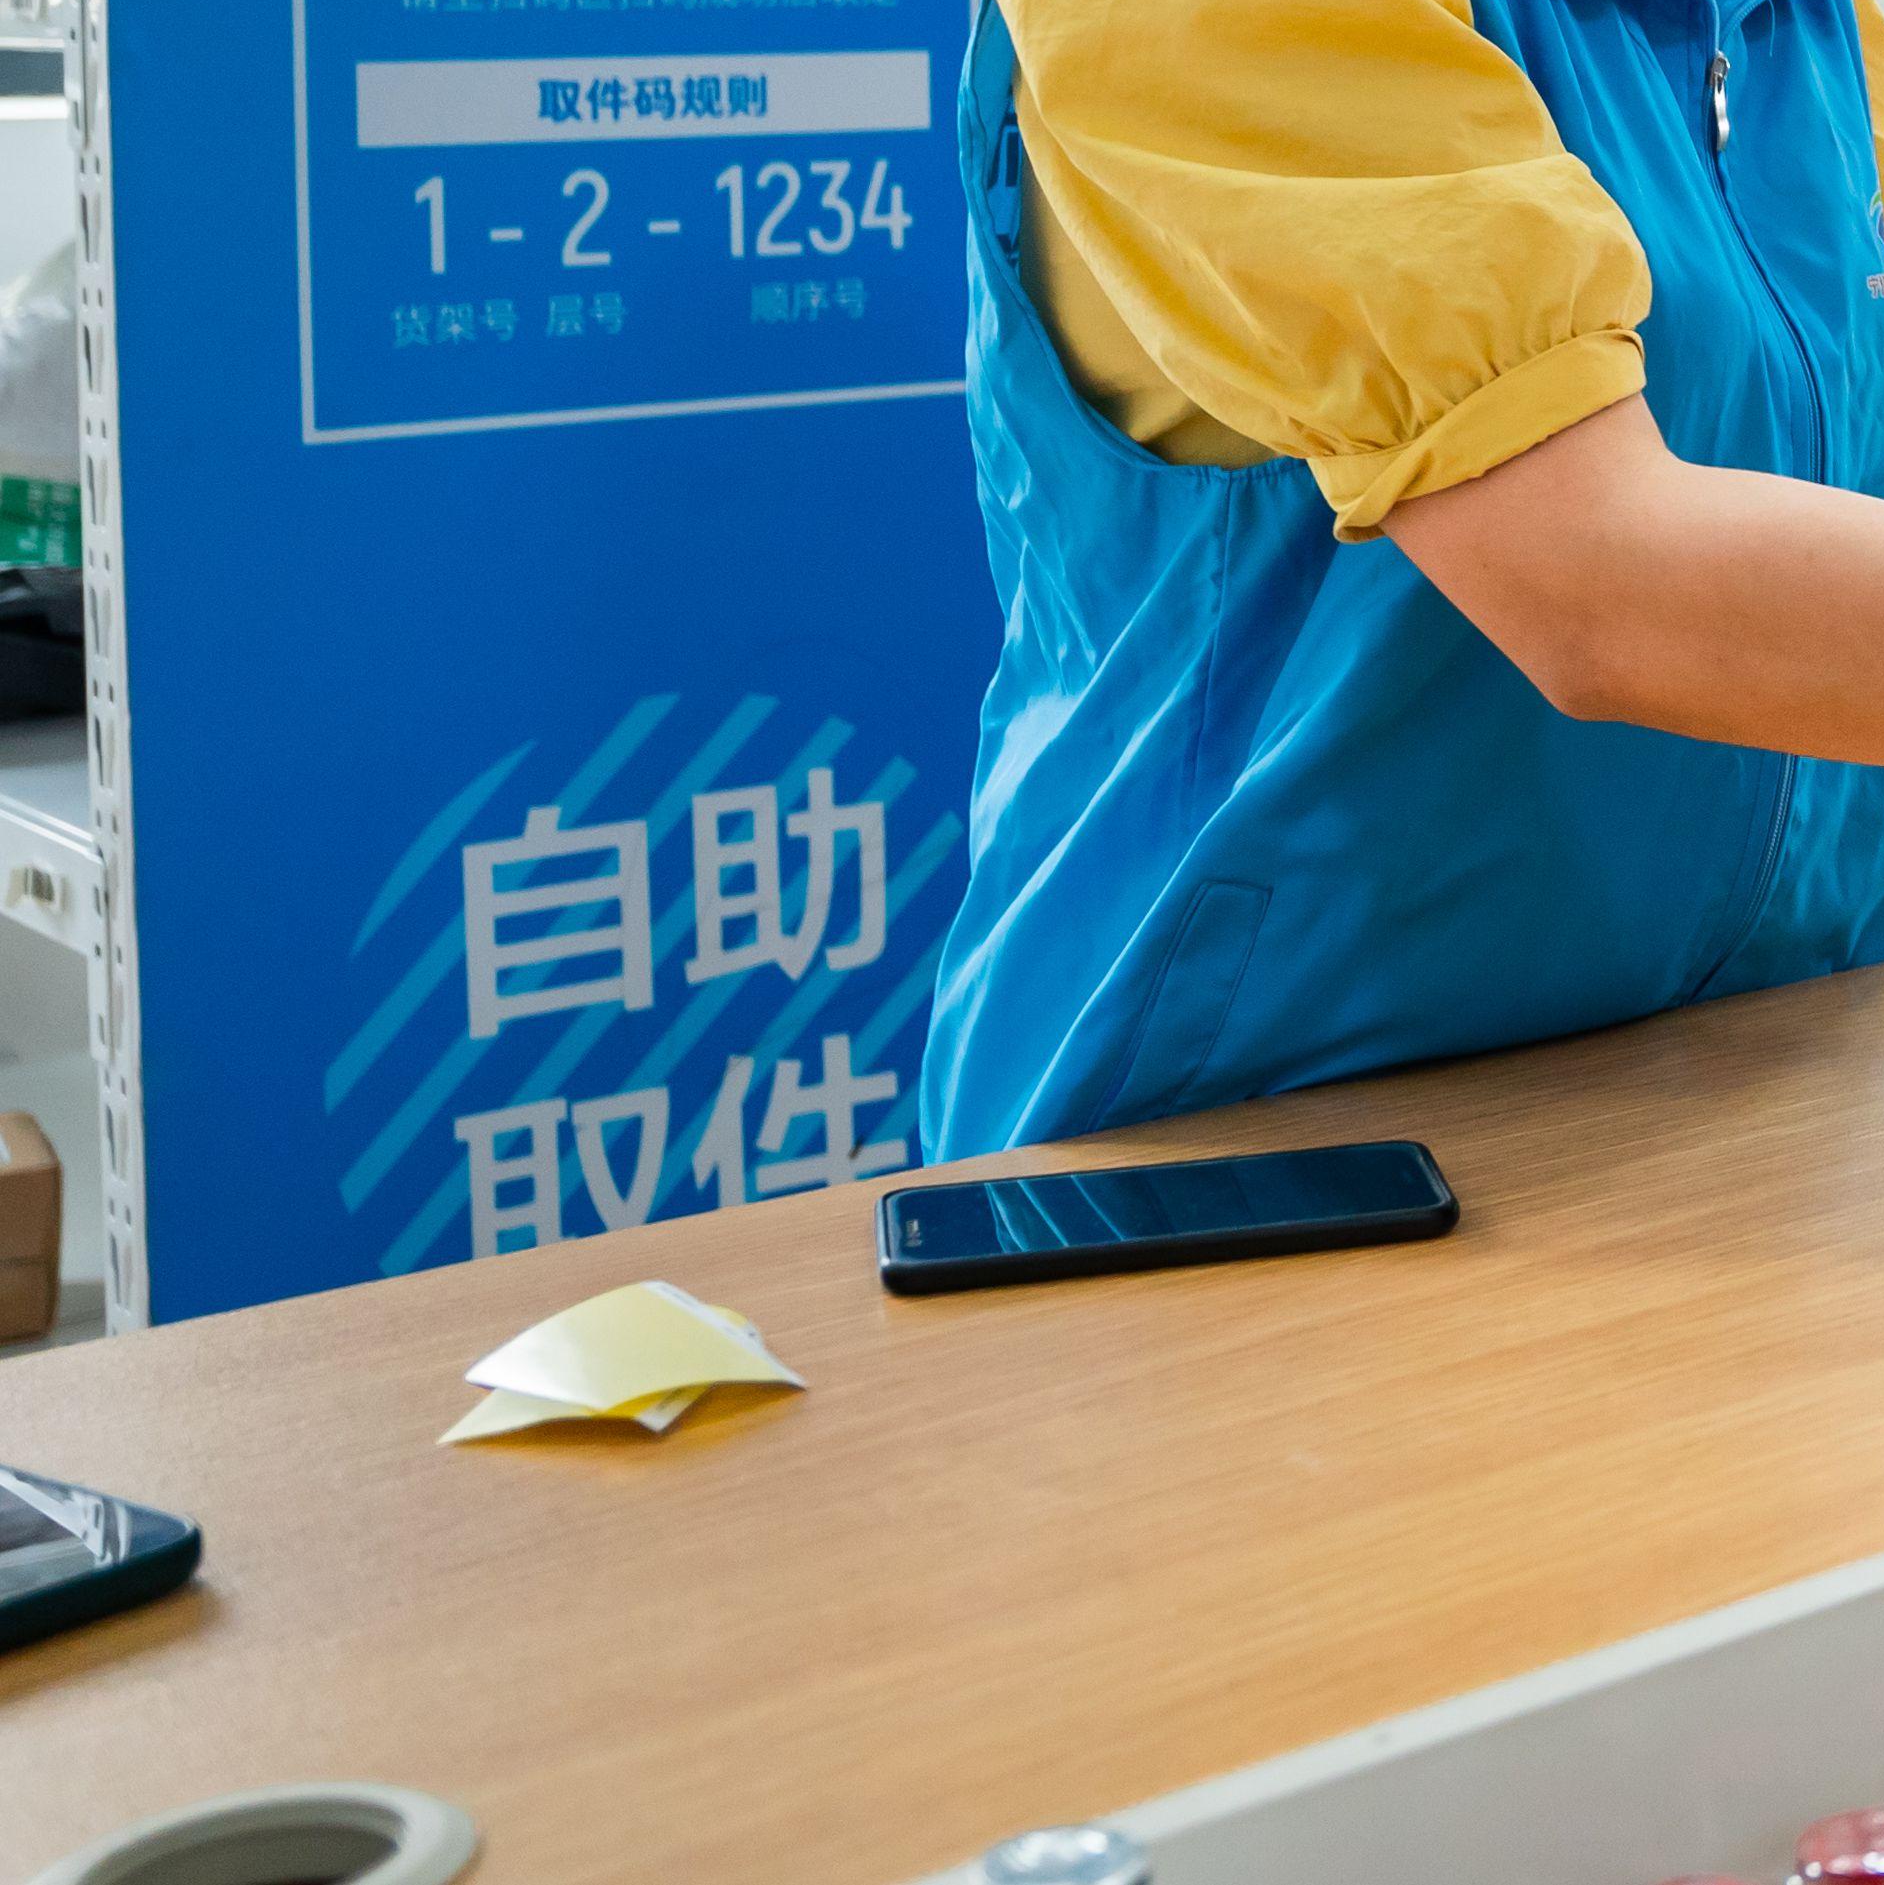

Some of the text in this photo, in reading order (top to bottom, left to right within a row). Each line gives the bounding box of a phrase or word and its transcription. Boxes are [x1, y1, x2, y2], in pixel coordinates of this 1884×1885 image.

[537, 76, 767, 123] 取件码规则
[461, 767, 888, 1040] 自助
